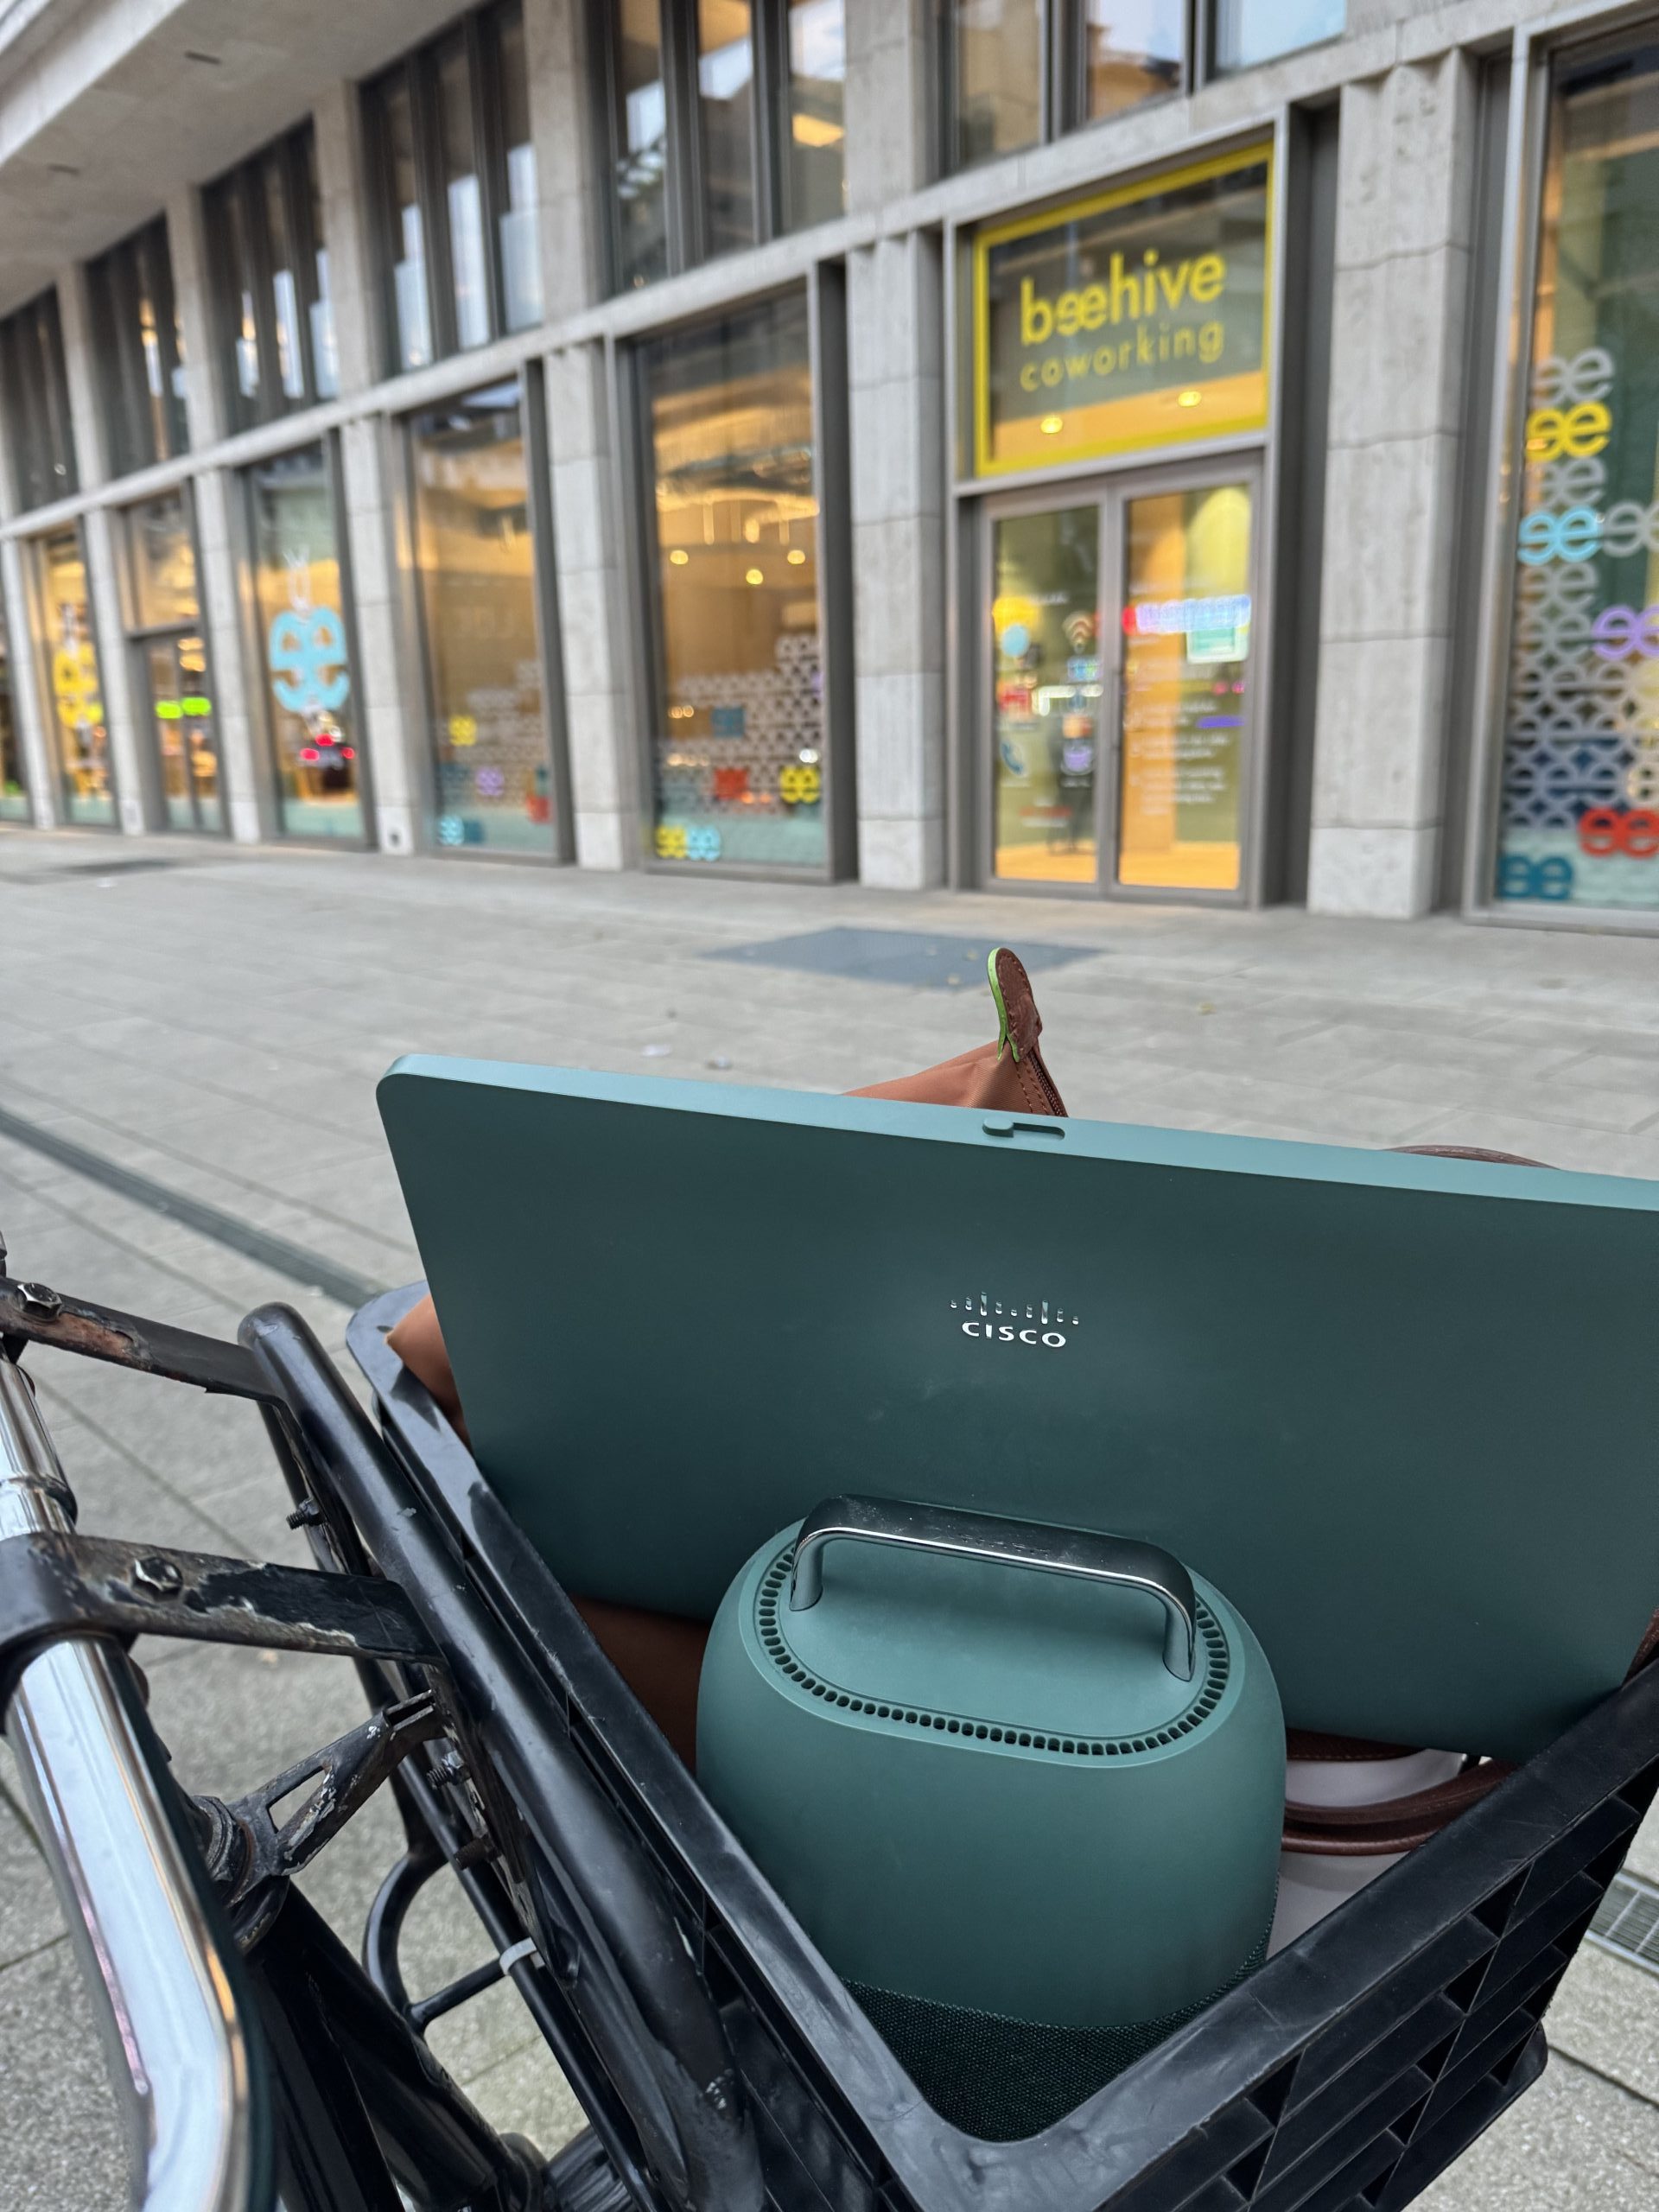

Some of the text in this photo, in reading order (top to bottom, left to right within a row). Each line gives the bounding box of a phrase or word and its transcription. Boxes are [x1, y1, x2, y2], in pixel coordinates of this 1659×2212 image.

[1020, 249, 1225, 346] beehive
[1020, 321, 1224, 392] coworking
[962, 1321, 1066, 1348] CISCO
